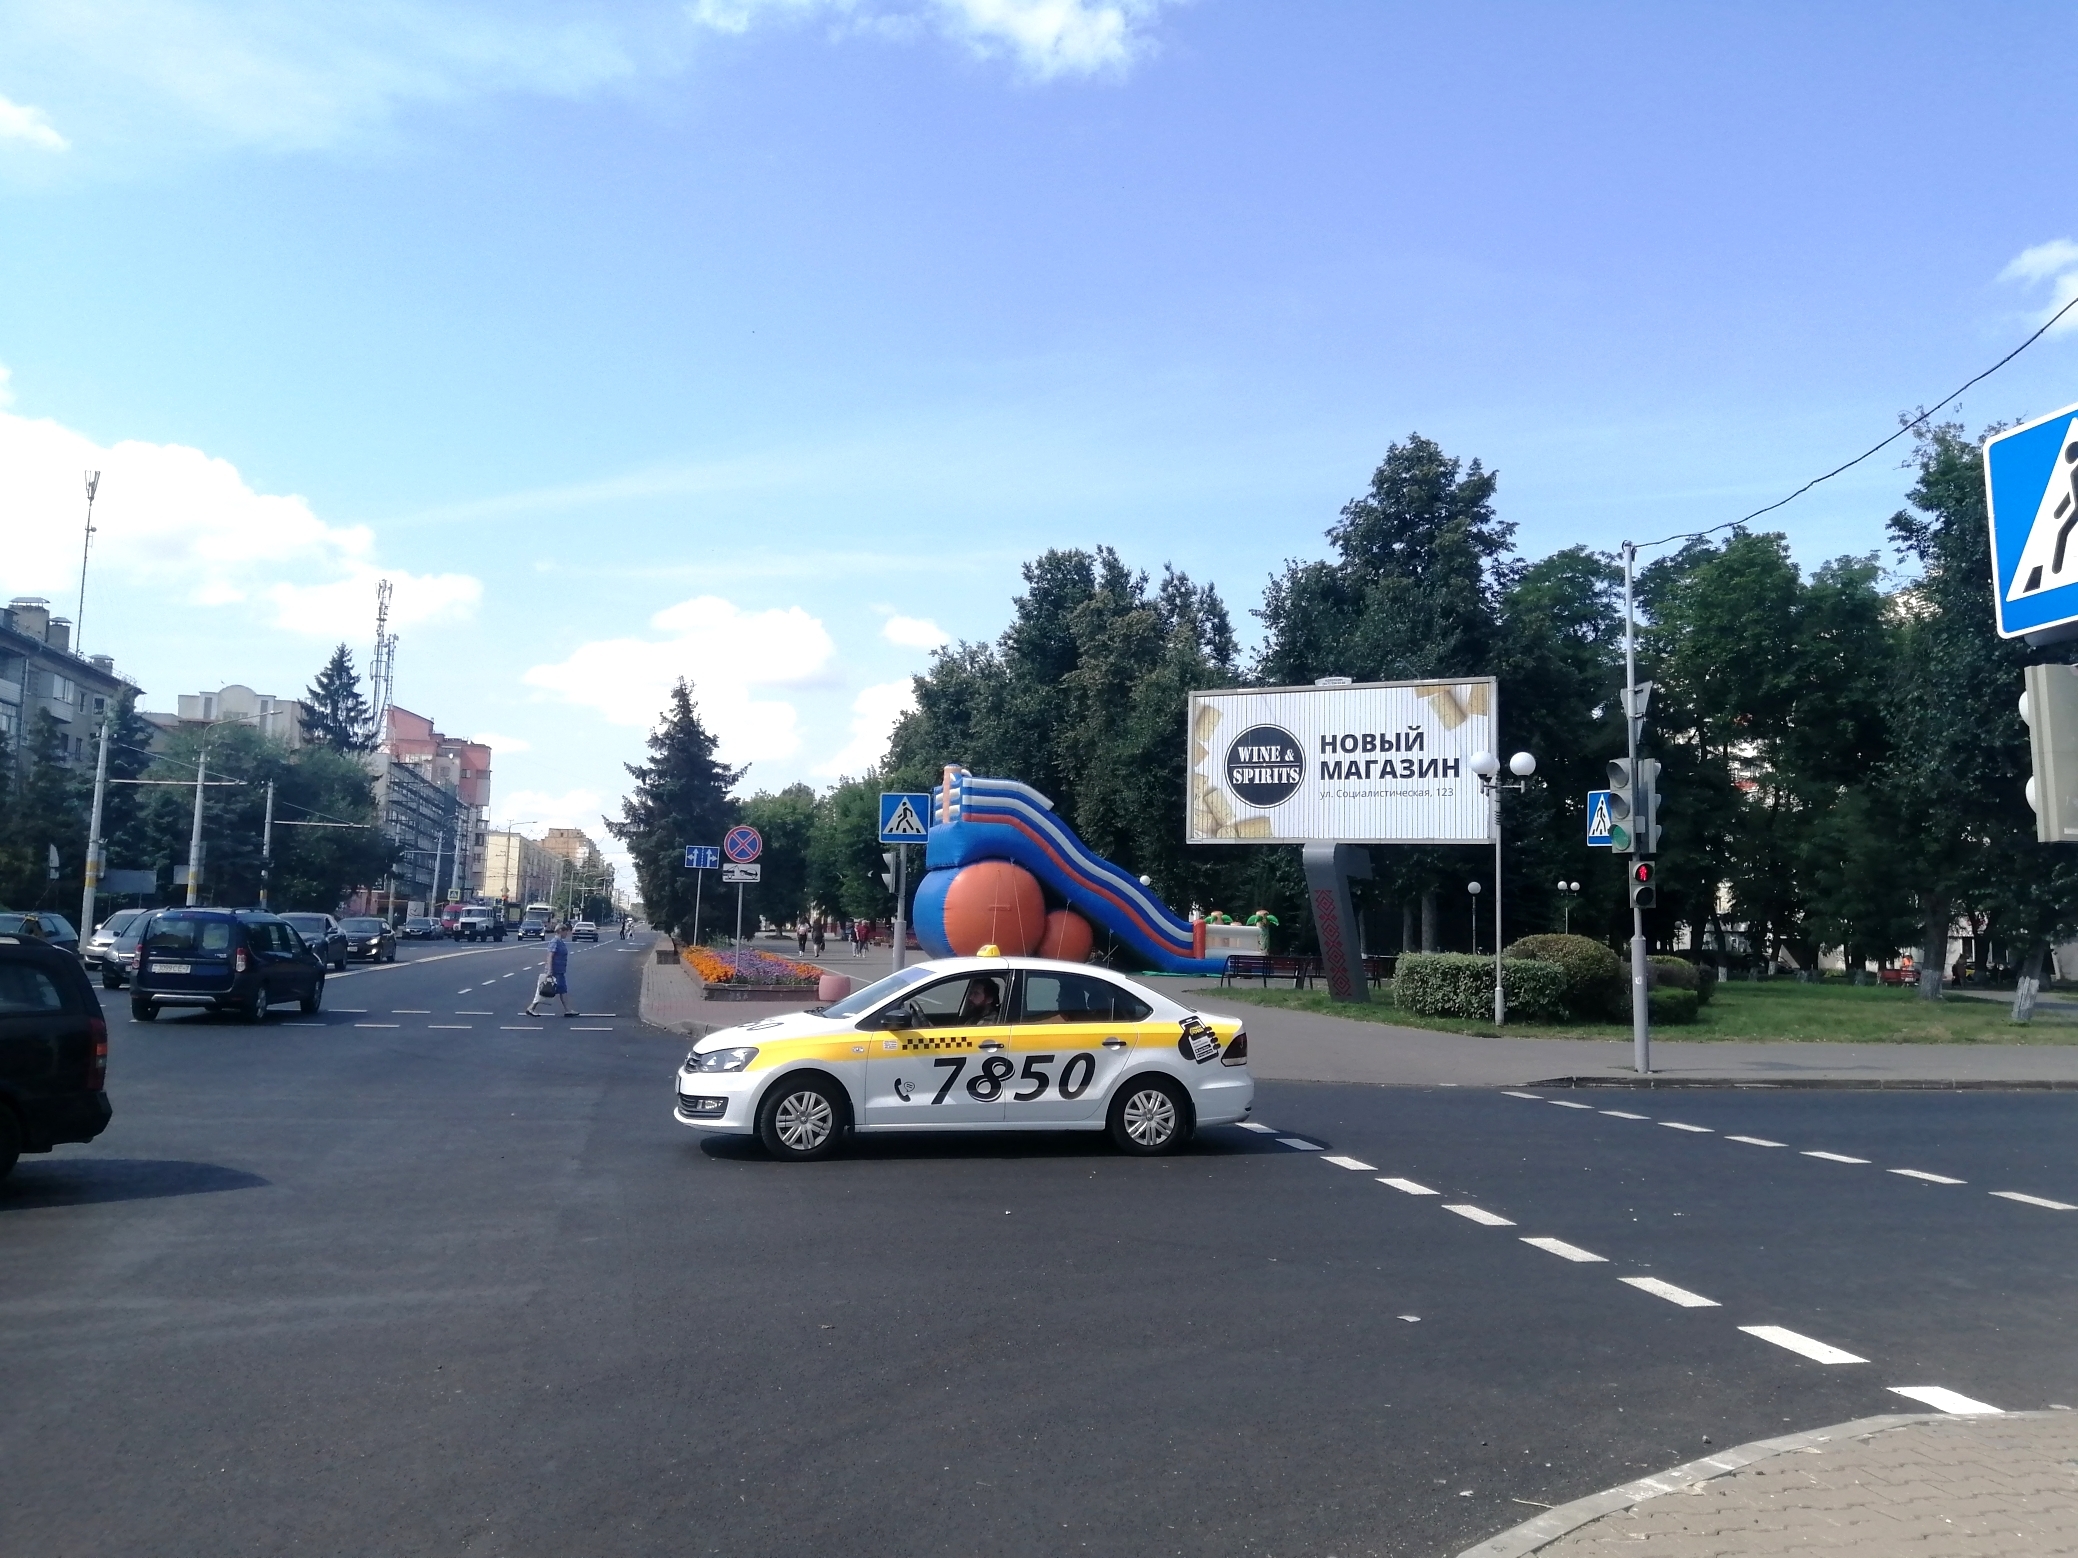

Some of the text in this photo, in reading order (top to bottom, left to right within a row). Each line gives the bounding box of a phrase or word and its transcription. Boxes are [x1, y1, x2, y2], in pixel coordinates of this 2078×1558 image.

[1320, 725, 1424, 754] НОВЫЙ
[1237, 746, 1295, 762] WINE &
[1232, 768, 1300, 784] SPIRITS
[1320, 758, 1460, 781] МАГАЗИН
[1319, 787, 1454, 801] ул. Социалистическая, 123
[930, 1052, 1096, 1105] 7850
